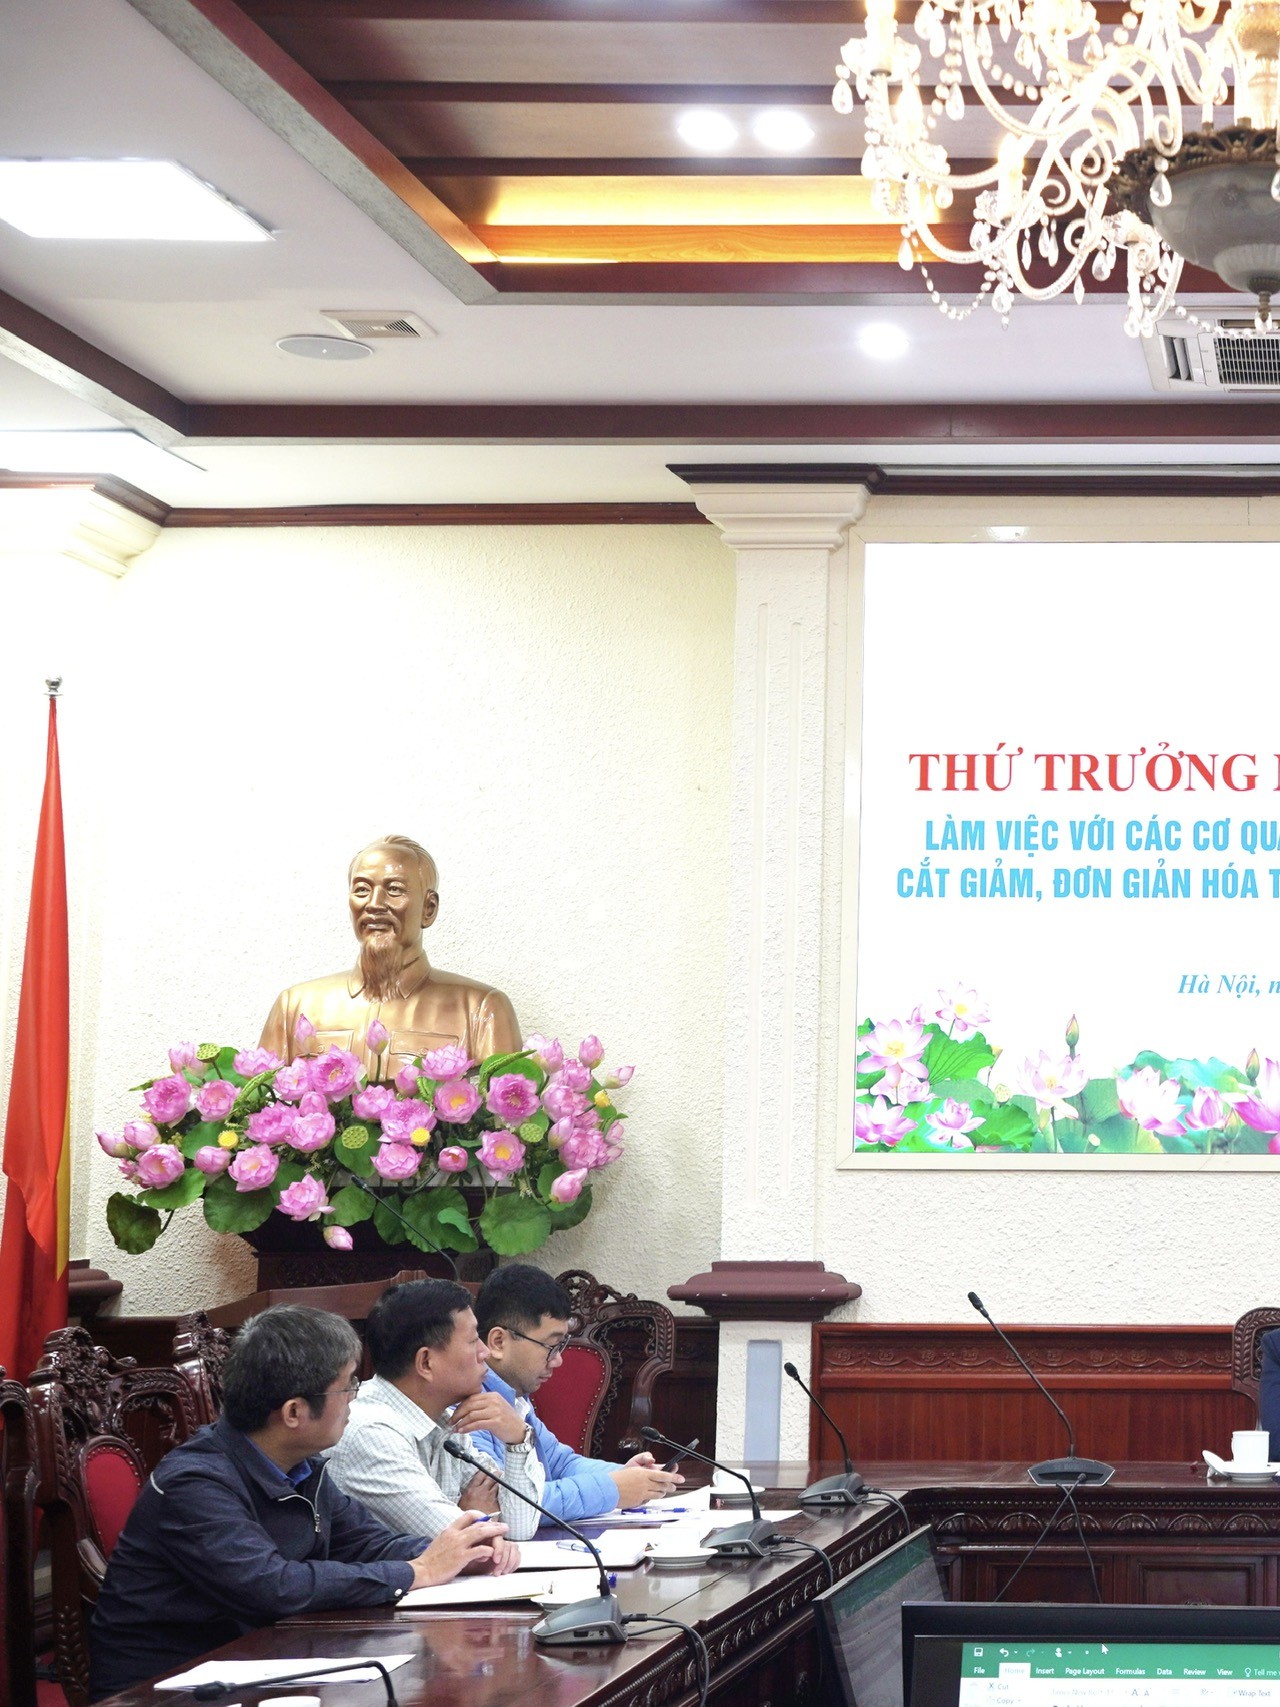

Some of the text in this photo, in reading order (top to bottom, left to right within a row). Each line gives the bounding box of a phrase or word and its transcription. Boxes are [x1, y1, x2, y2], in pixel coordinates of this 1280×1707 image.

[909, 742, 1023, 792] THỨ
[1034, 742, 1259, 792] TRƯỞNG
[925, 814, 985, 851] LÀM
[996, 814, 1059, 858] VIỆC
[1069, 814, 1114, 851] VỚI
[1126, 814, 1181, 851] CÁC
[1193, 818, 1231, 851] CƠ
[897, 857, 950, 898] CẮT
[960, 858, 1042, 902] GIẢM,
[1053, 865, 1112, 898] ĐƠN
[1123, 858, 1191, 898] GIẢN
[1202, 862, 1259, 899] HÓA
[1178, 974, 1210, 994] Hà
[1217, 974, 1261, 999] Nội,
[1036, 1667, 1055, 1675] Insert
[1065, 1668, 1105, 1677] Page Layout
[1183, 1668, 1206, 1676] Review
[1217, 1668, 1233, 1676] View
[1239, 1689, 1271, 1698] Wrap Text
[997, 1697, 1014, 1705] Copy
